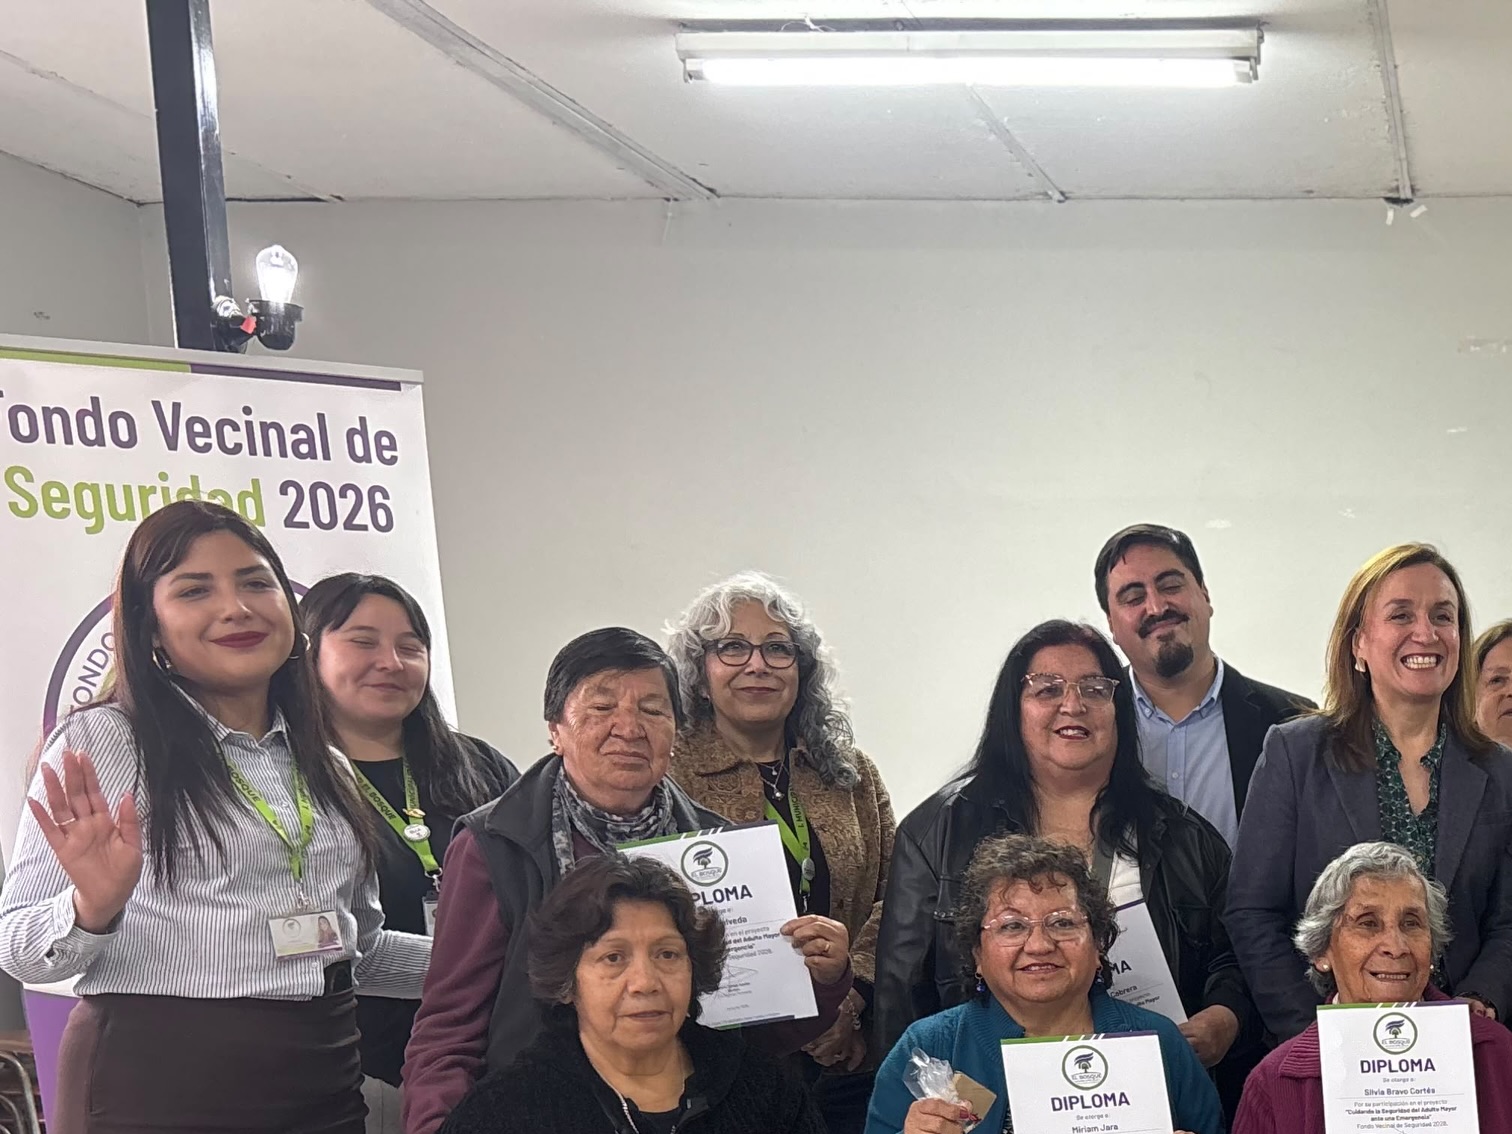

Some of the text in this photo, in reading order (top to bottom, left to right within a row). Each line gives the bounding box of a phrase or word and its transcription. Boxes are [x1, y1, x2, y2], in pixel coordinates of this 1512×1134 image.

[0, 391, 400, 466] ondo Vecinal de
[278, 479, 394, 533] 2026
[70, 632, 115, 713] ONDO
[228, 766, 261, 802] OSQUE
[369, 792, 397, 820] BOSQUE
[690, 884, 753, 905] PLOMA
[725, 916, 748, 925] lveda
[1110, 985, 1137, 998] Cabrera
[1360, 1058, 1435, 1073] DIPLOMA
[1051, 1092, 1130, 1111] DIPLOMA
[1364, 1088, 1385, 1096] Silvia
[1410, 1087, 1435, 1095] Cortés
[1072, 1124, 1118, 1134] Miriam Jara
